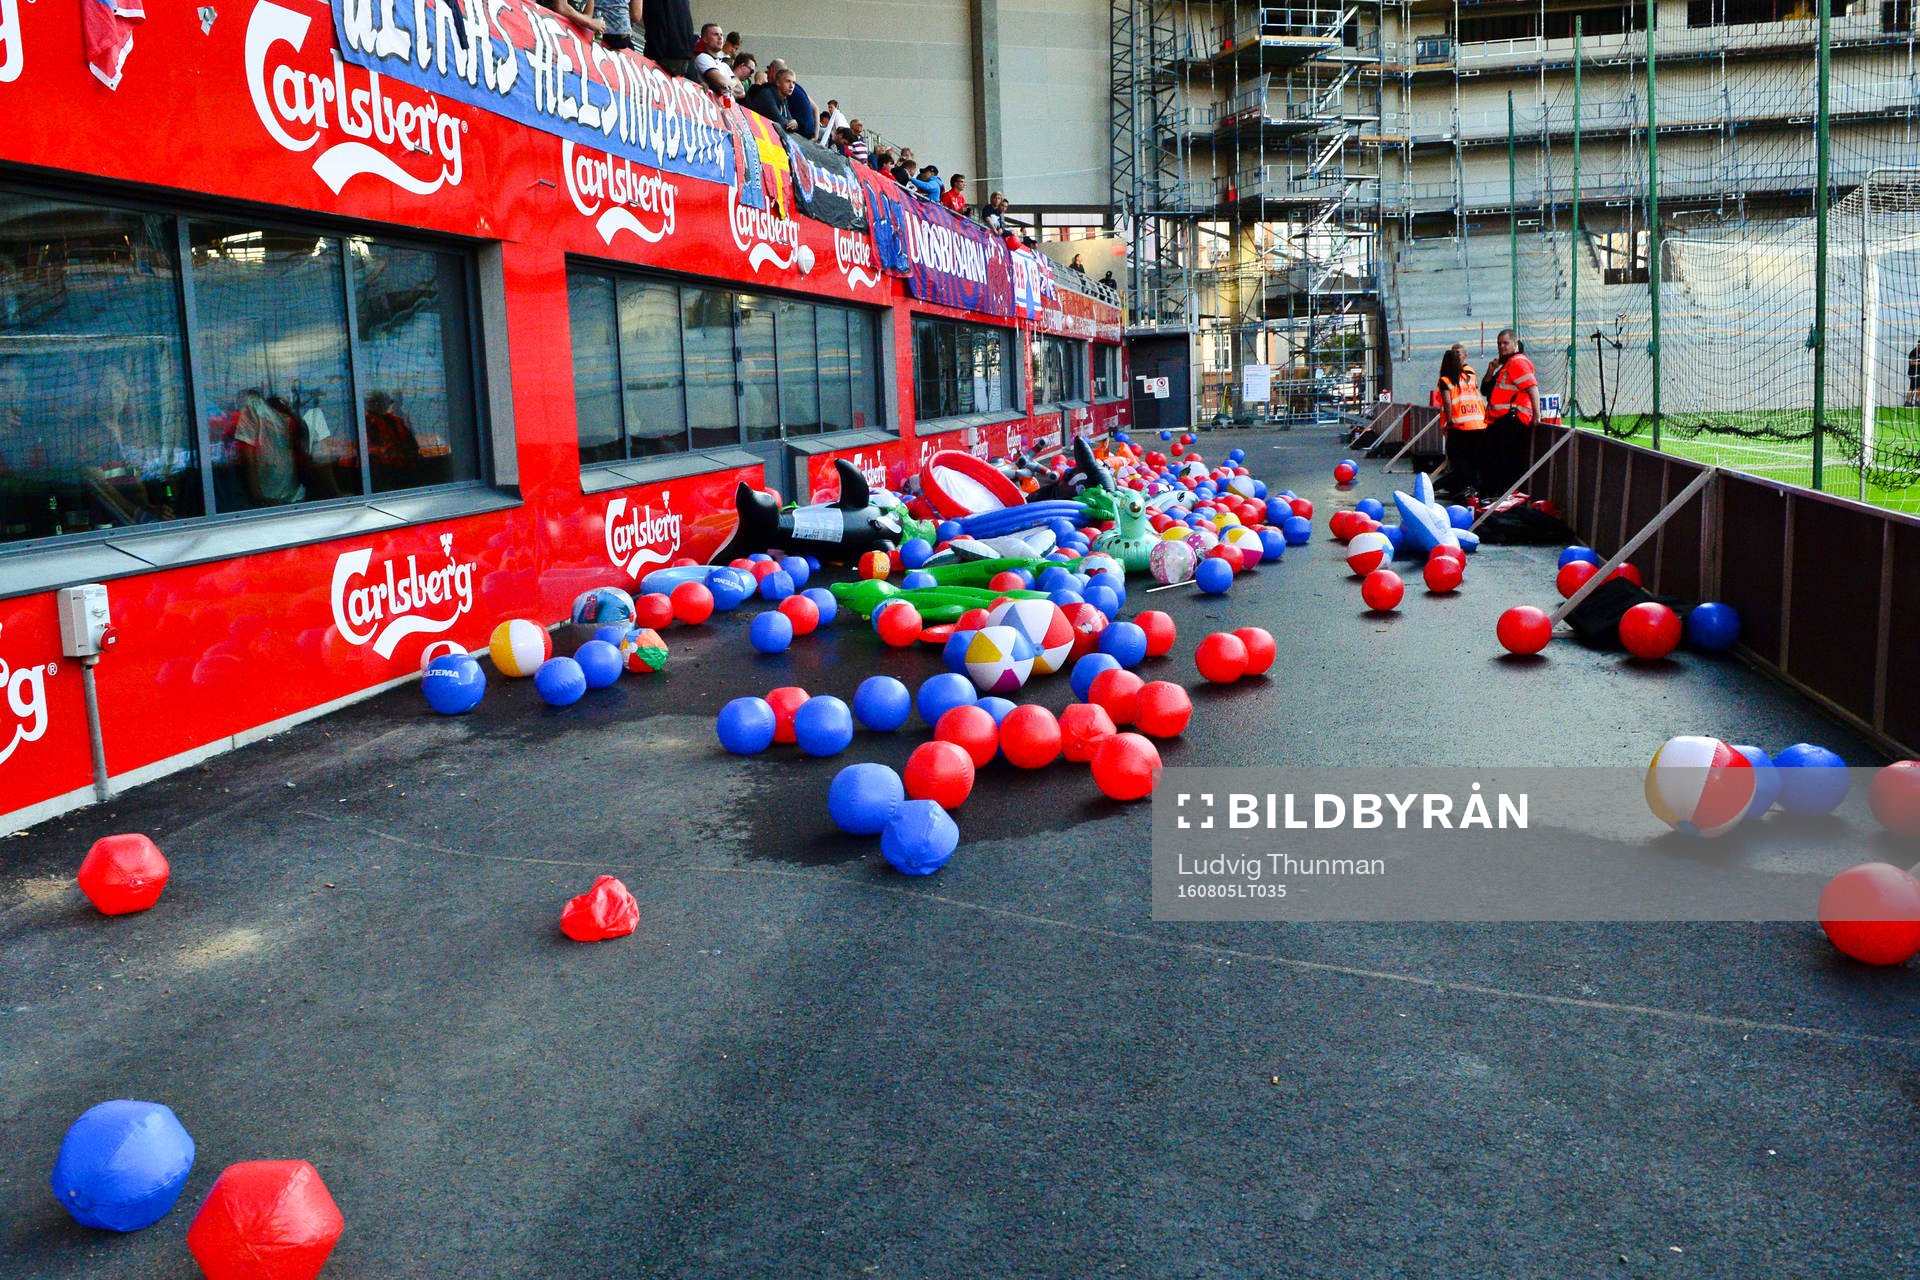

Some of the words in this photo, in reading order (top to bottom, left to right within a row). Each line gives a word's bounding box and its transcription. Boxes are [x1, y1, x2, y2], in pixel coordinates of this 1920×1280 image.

[245, 0, 462, 186] Carlsberg
[834, 228, 876, 276] Carlsbe
[604, 497, 682, 568] Carlsberg
[331, 548, 474, 646] Carlsberg
